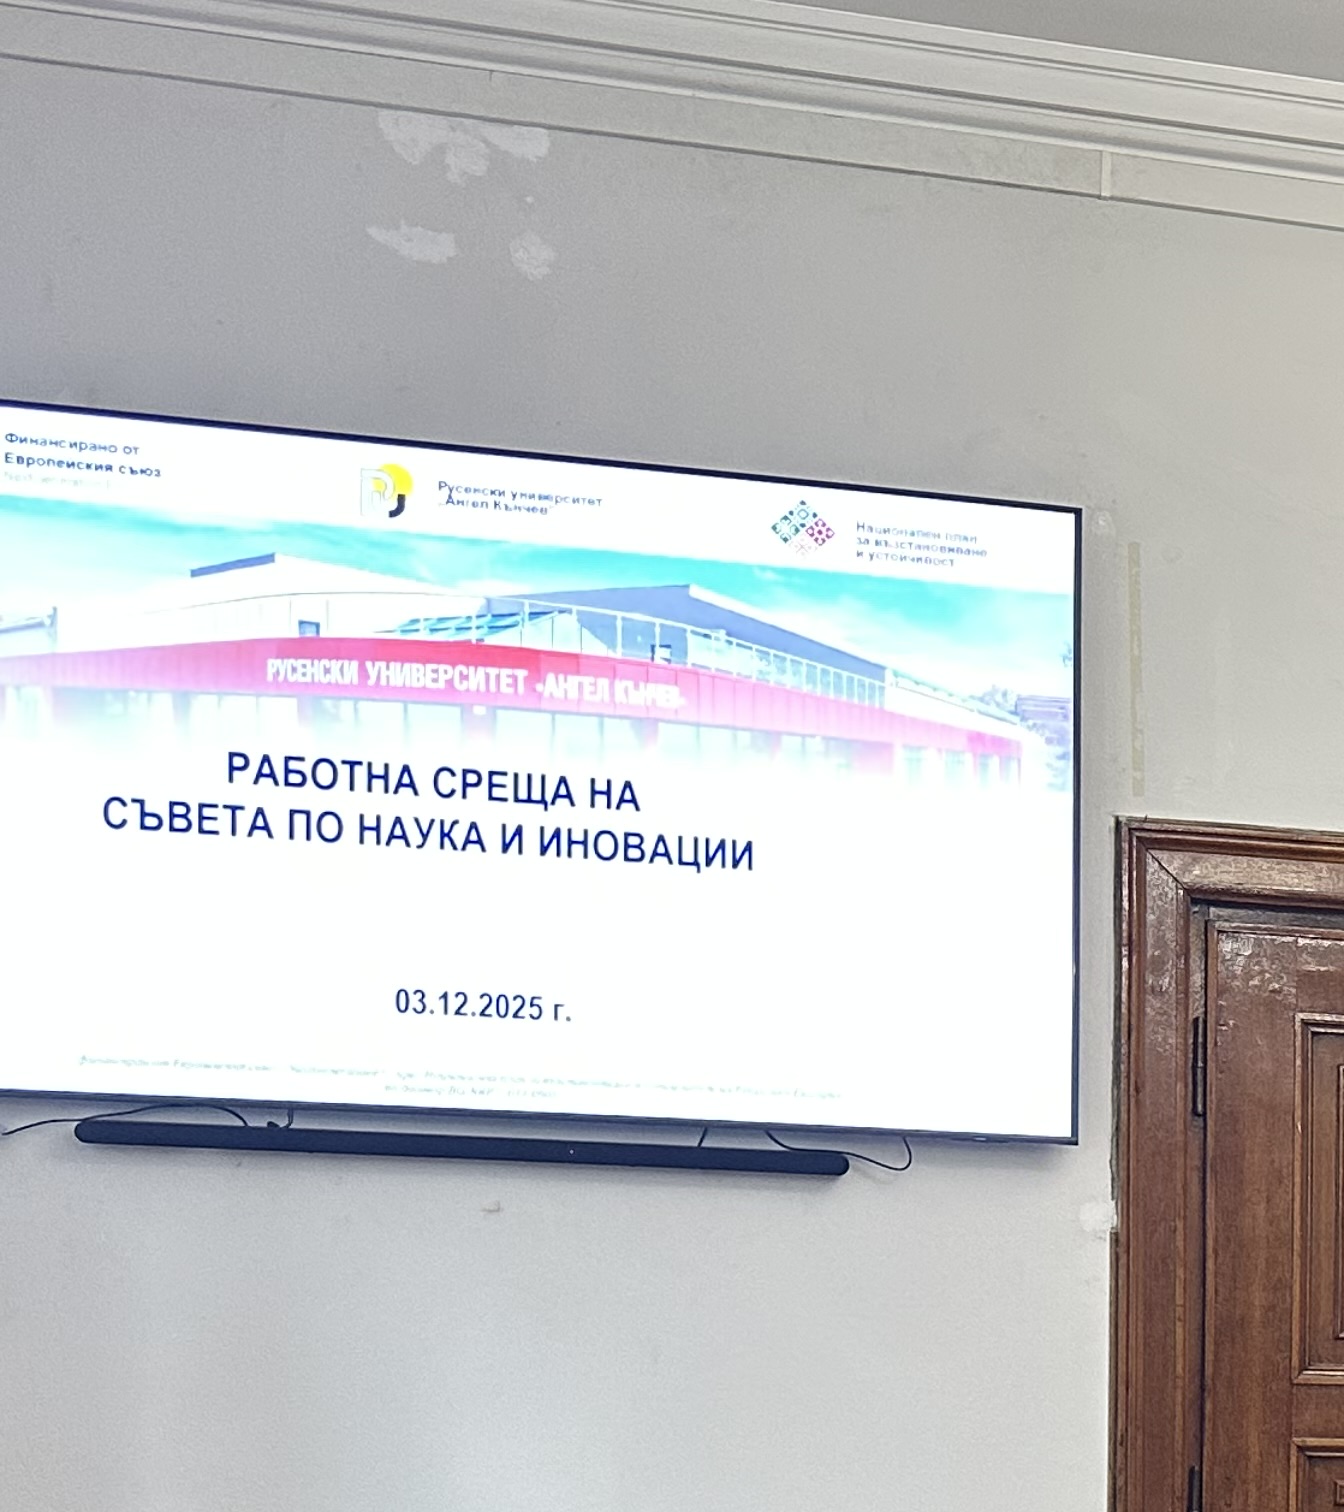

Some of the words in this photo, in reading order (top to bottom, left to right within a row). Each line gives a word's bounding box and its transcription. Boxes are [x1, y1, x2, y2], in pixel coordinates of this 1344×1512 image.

[5, 432, 118, 453] Финансирано
[123, 445, 140, 455] от
[118, 464, 161, 478] съюз
[266, 658, 359, 685] РУСЕНСКИ
[364, 660, 528, 695] УНИВЕРСИТЕТ
[228, 751, 419, 796] РАБОТНА
[433, 766, 576, 812] СРЕЩА
[590, 777, 641, 812] НА
[103, 796, 274, 839] СЪВЕТА
[289, 809, 344, 843] ПО
[359, 813, 487, 853] НАУКА
[501, 823, 523, 855] И
[540, 825, 753, 873] ИНОВАЦИИ
[395, 988, 543, 1020] 03.12.2025
[553, 1003, 572, 1022] г.
